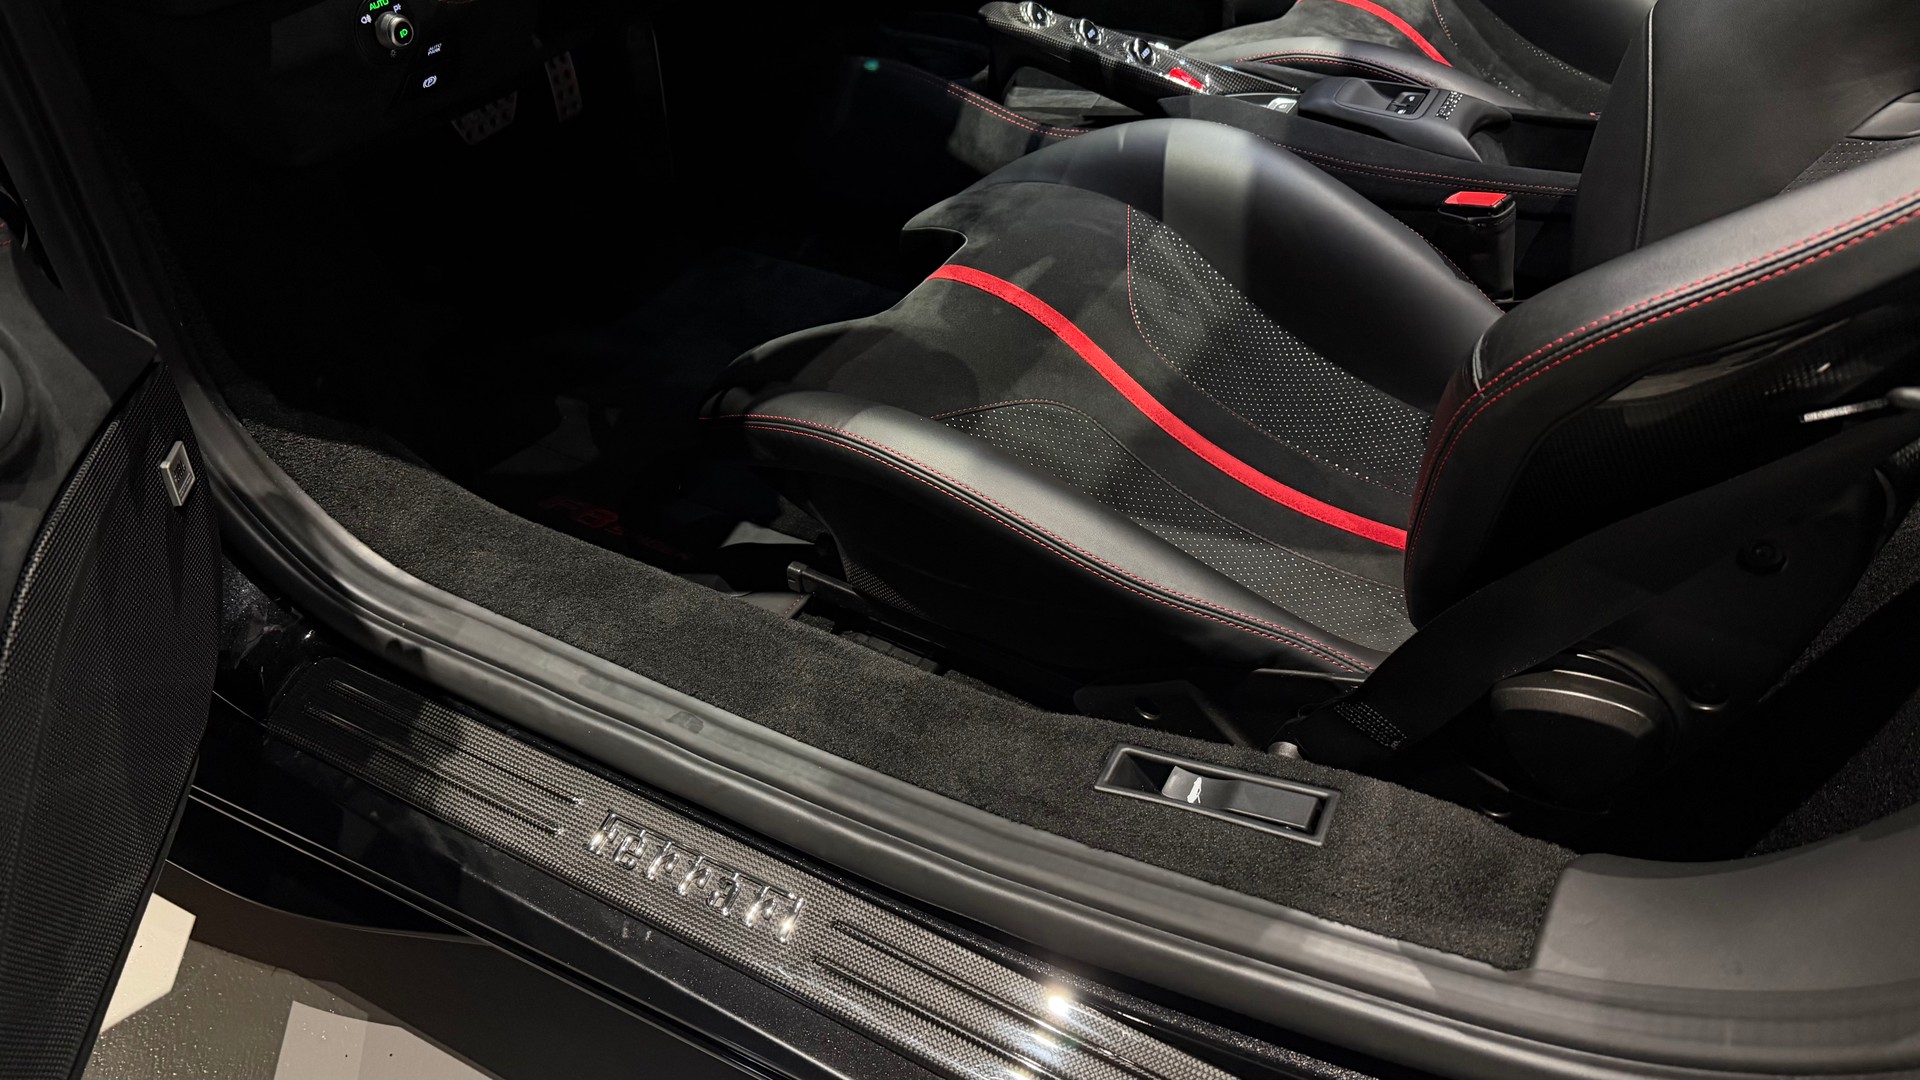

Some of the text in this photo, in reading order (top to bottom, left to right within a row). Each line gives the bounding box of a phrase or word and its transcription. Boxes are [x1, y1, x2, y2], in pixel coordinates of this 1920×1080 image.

[369, 0, 389, 11] AUTO
[428, 43, 442, 51] AUTO
[584, 809, 806, 944] Ferrari
